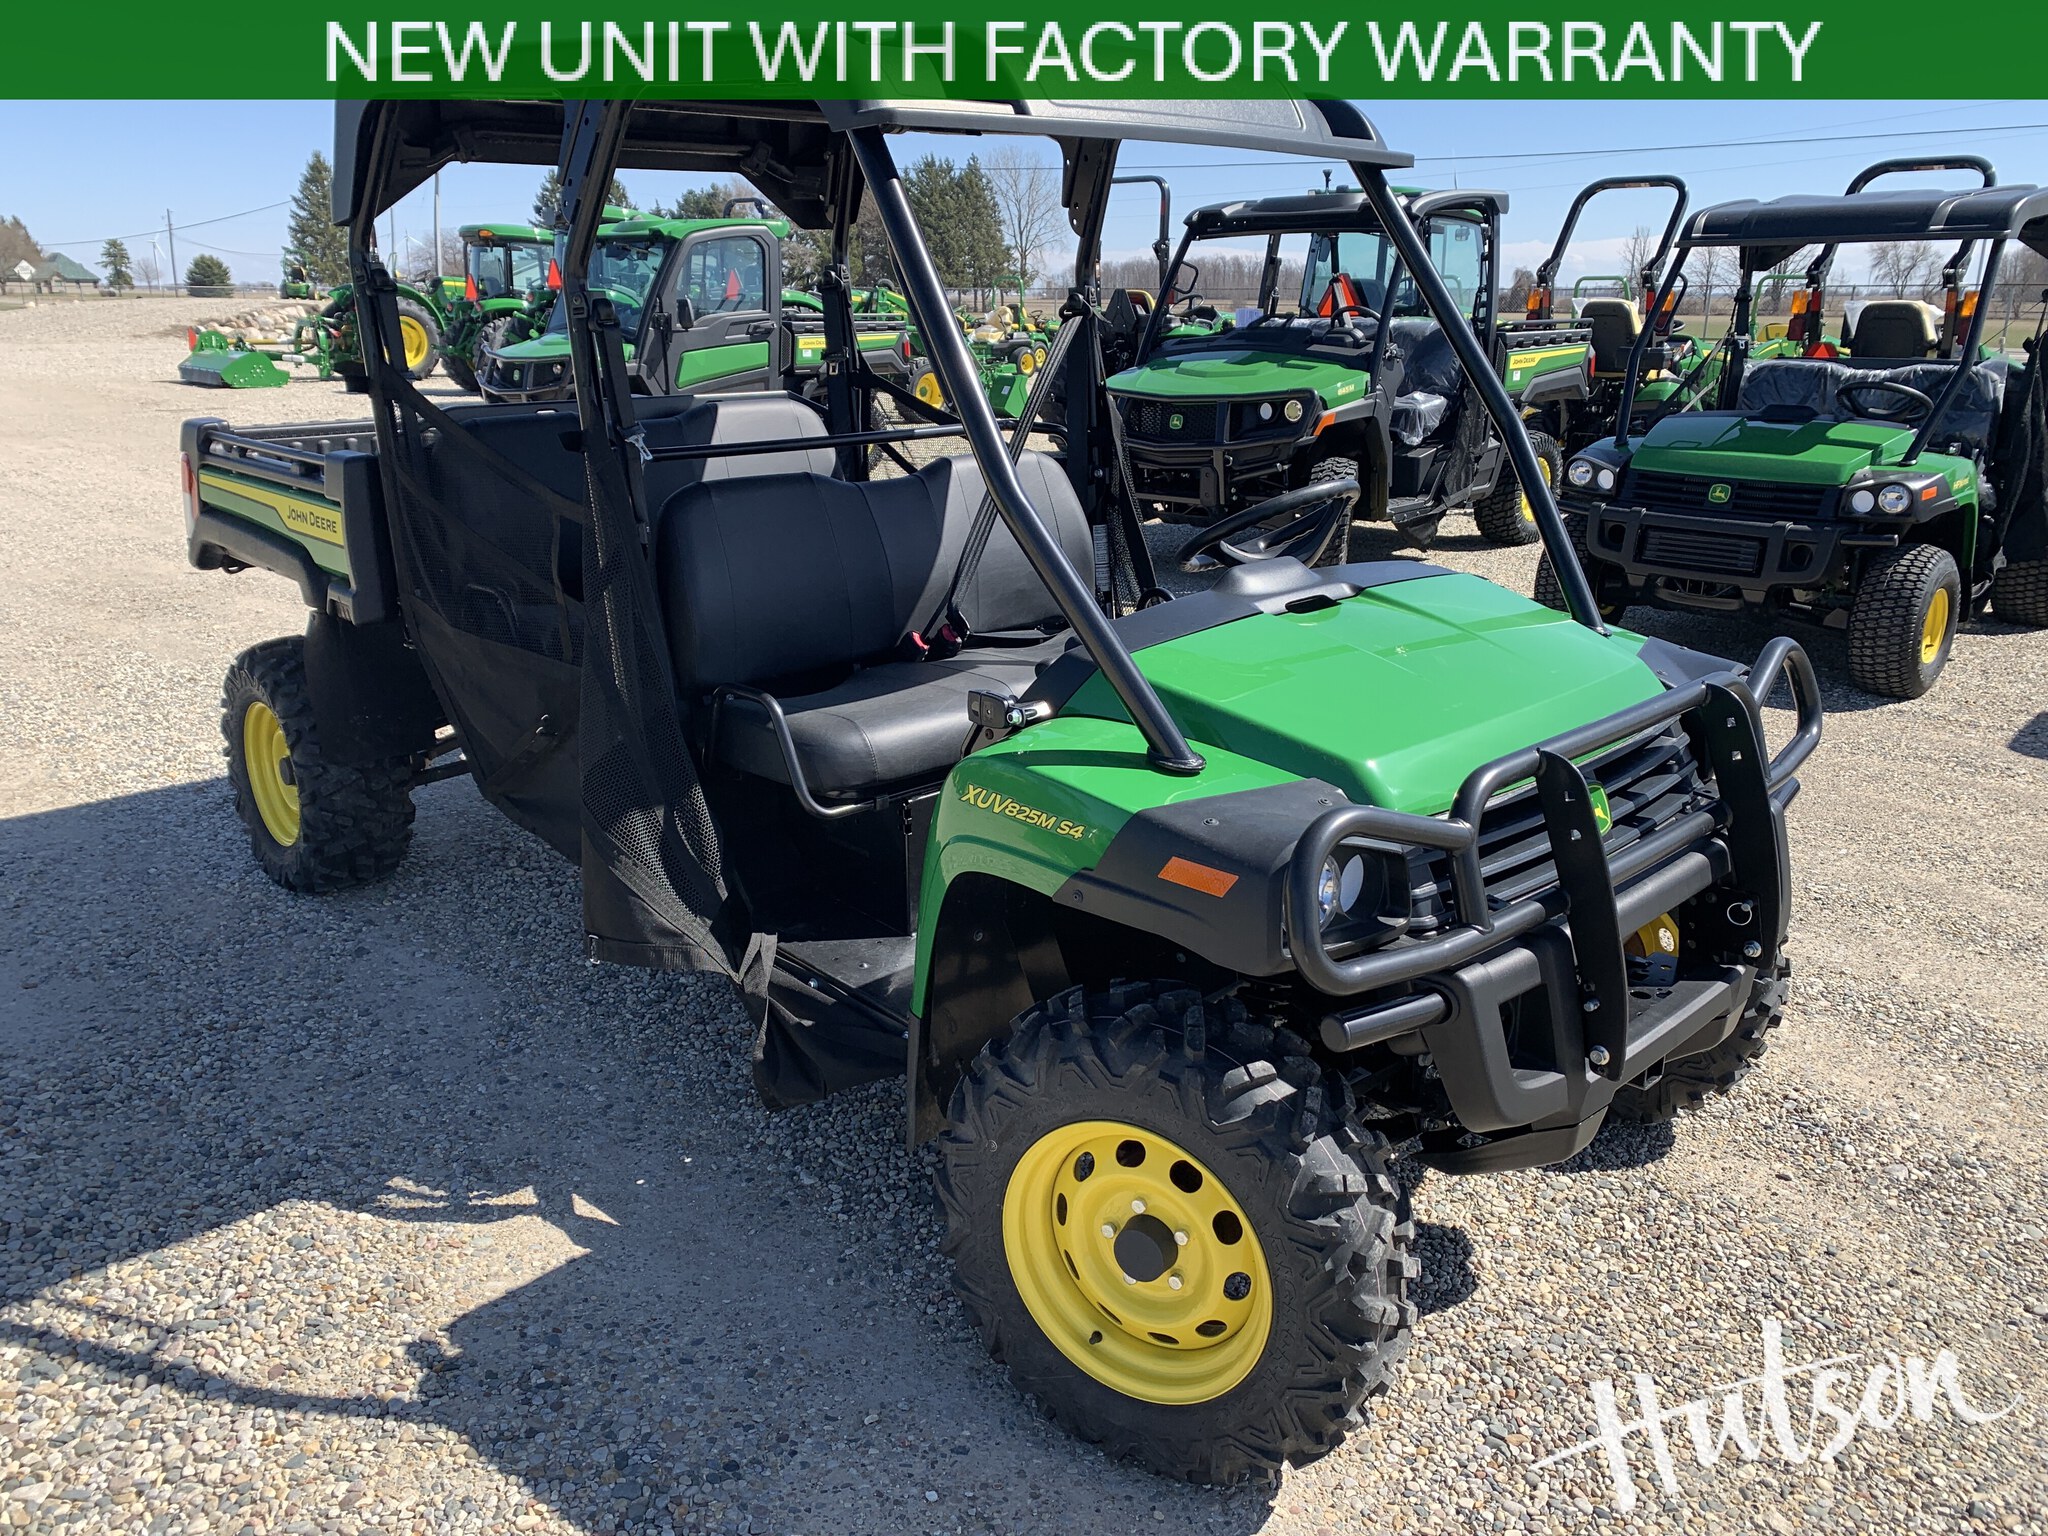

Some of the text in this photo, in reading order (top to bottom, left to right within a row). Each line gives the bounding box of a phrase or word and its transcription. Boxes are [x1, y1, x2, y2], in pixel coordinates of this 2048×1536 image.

[287, 504, 337, 534] JOHN DEERE
[960, 783, 1087, 842] XUV825M S4
